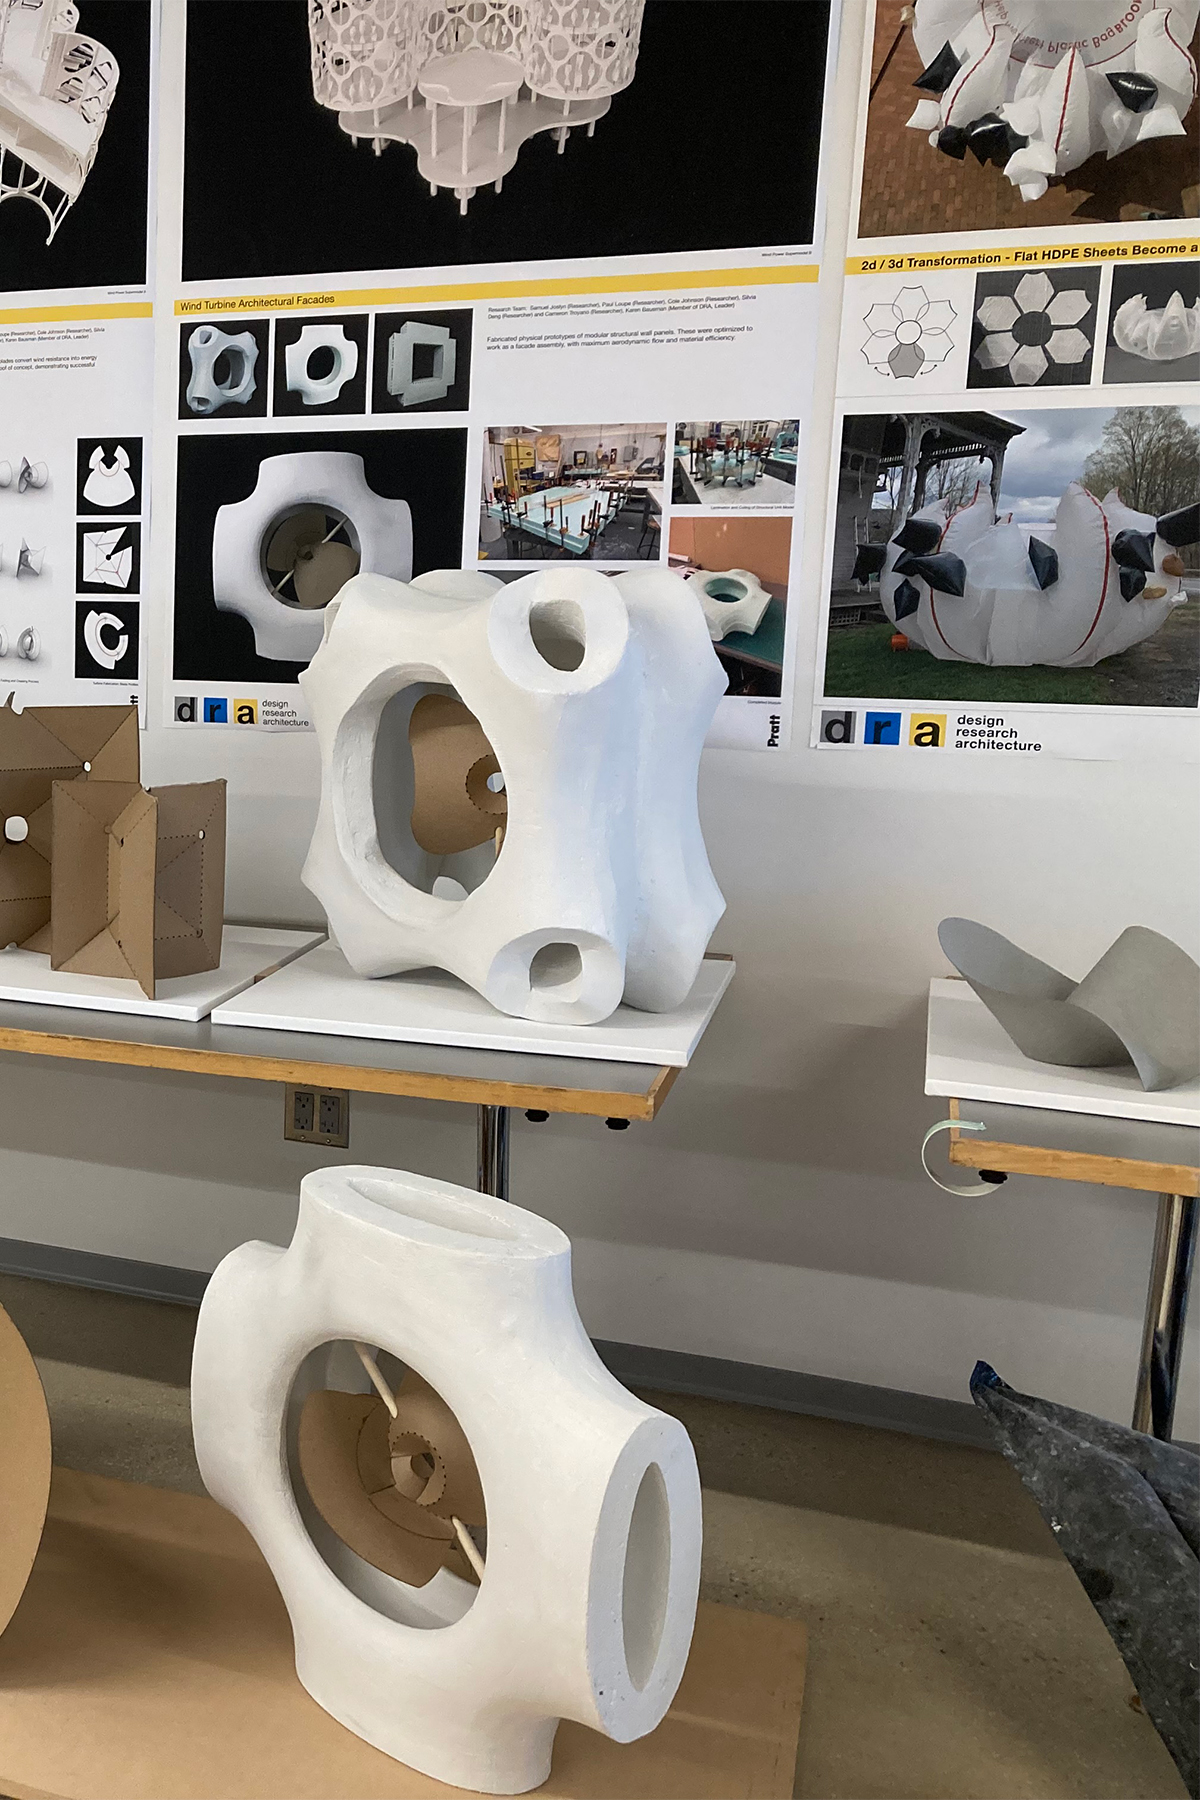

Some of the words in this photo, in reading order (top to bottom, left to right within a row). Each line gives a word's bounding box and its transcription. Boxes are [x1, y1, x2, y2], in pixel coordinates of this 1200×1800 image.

[861, 260, 876, 270] 2d
[880, 260, 885, 269] /
[888, 258, 903, 269] 3d
[907, 253, 1000, 268] Transformation
[1014, 251, 1038, 262] Flat
[1042, 249, 1079, 260] HDPE
[1083, 246, 1128, 258] Sheets
[1132, 243, 1186, 255] Become
[1191, 244, 1198, 252] a
[181, 303, 202, 312] Wind
[204, 301, 236, 311] Turbine
[238, 298, 294, 309] Architectural
[297, 295, 335, 306] Facades
[518, 335, 542, 343] physical
[544, 333, 575, 342] prototypes
[714, 326, 745, 334] optimized
[262, 700, 288, 709] design
[262, 709, 296, 717] research
[262, 718, 309, 726] architecture
[957, 714, 1004, 727] design
[767, 715, 780, 747] Pratt
[956, 727, 1018, 738] research
[955, 739, 1042, 751] architecture
